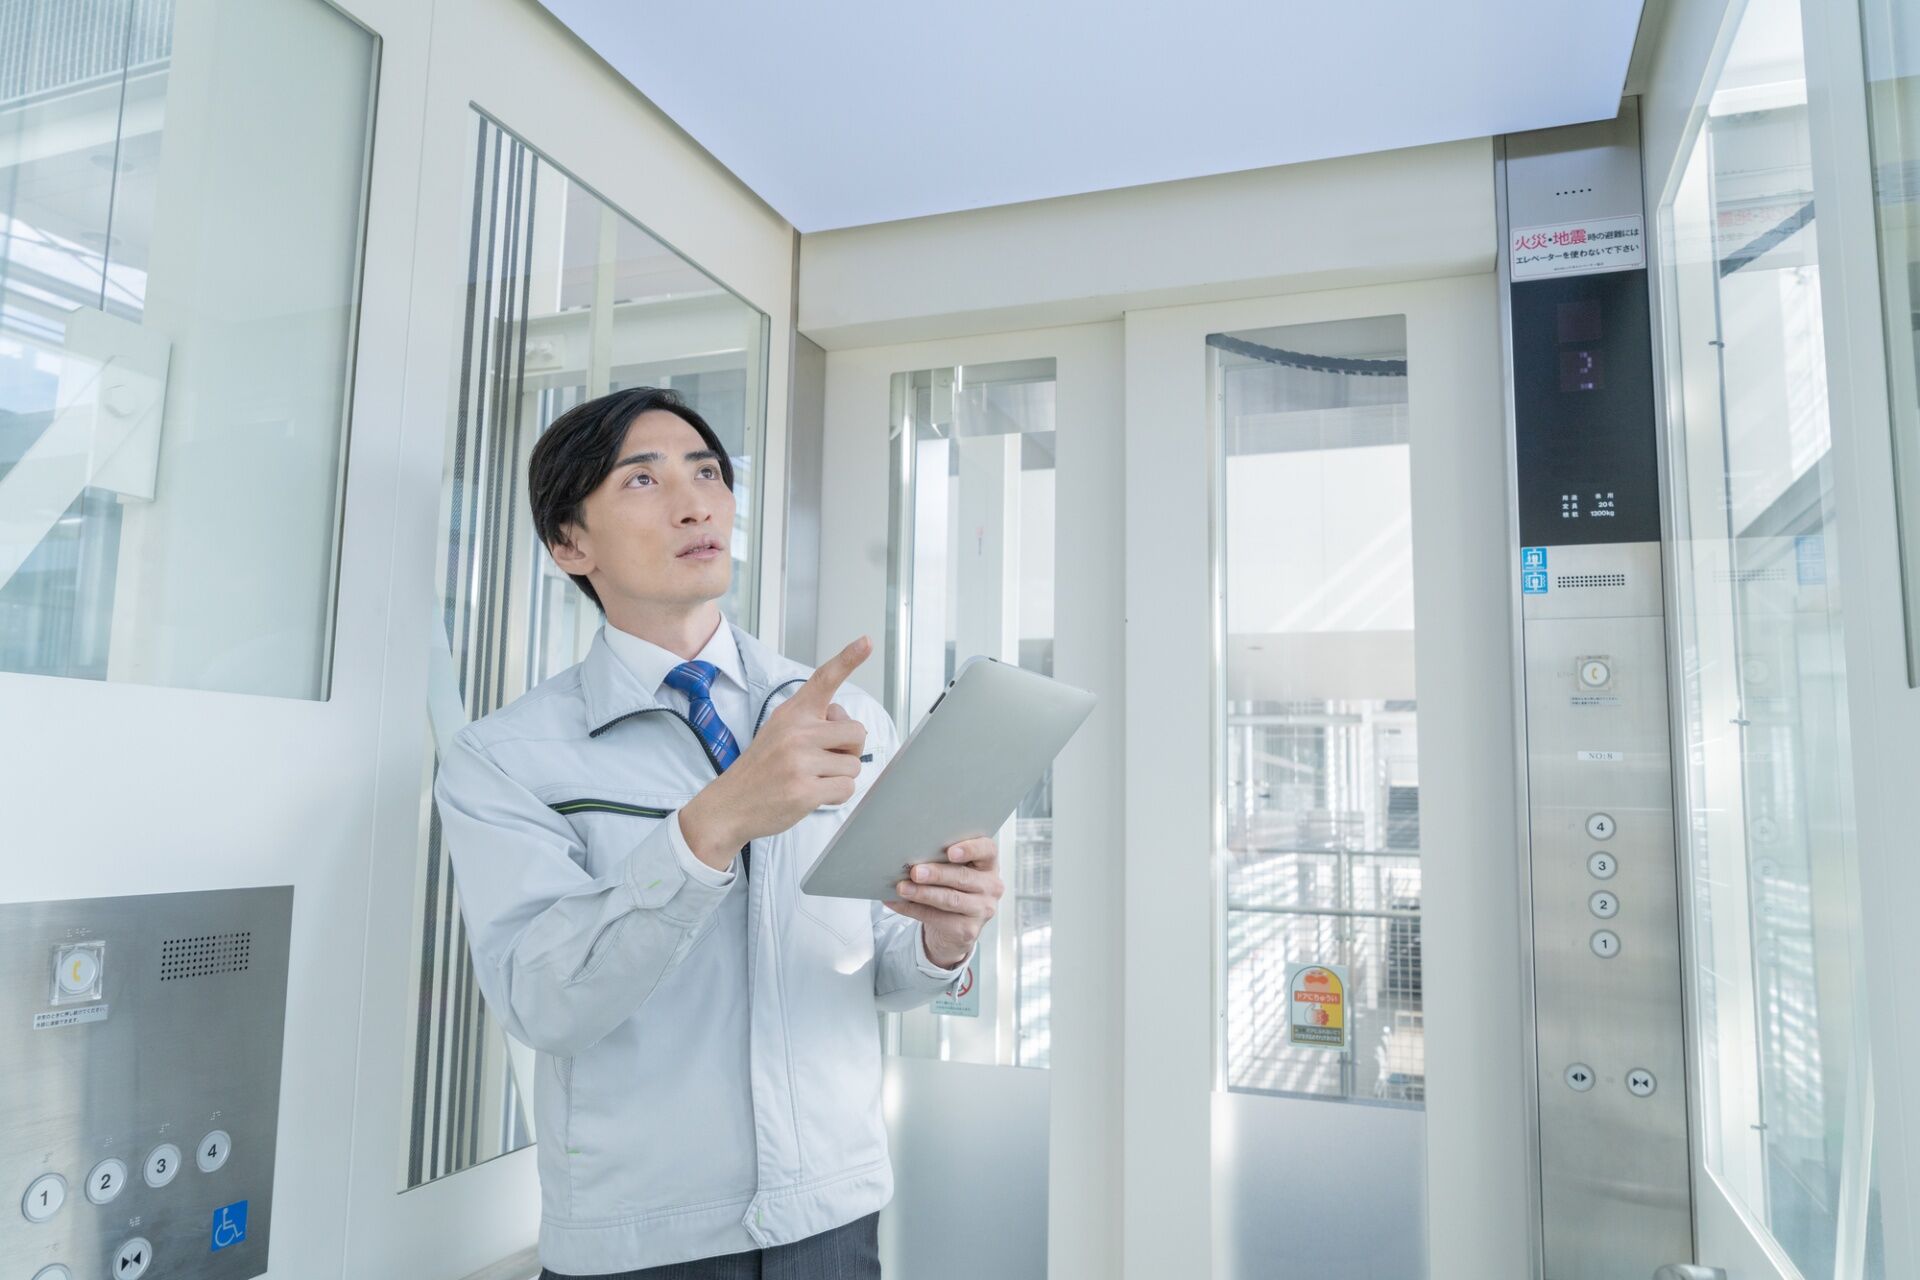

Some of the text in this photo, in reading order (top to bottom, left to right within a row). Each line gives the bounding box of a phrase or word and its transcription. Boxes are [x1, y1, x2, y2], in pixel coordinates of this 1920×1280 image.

[1516, 244, 1639, 264] エレベーターを使わないで下さい
[1596, 822, 1605, 831] 4
[1598, 861, 1607, 871] 3
[1599, 900, 1608, 910] 2
[1602, 939, 1607, 949] 1
[207, 1144, 217, 1158] 4
[156, 1158, 166, 1173] 3
[100, 1173, 111, 1190] 2
[40, 1190, 49, 1206] 1
